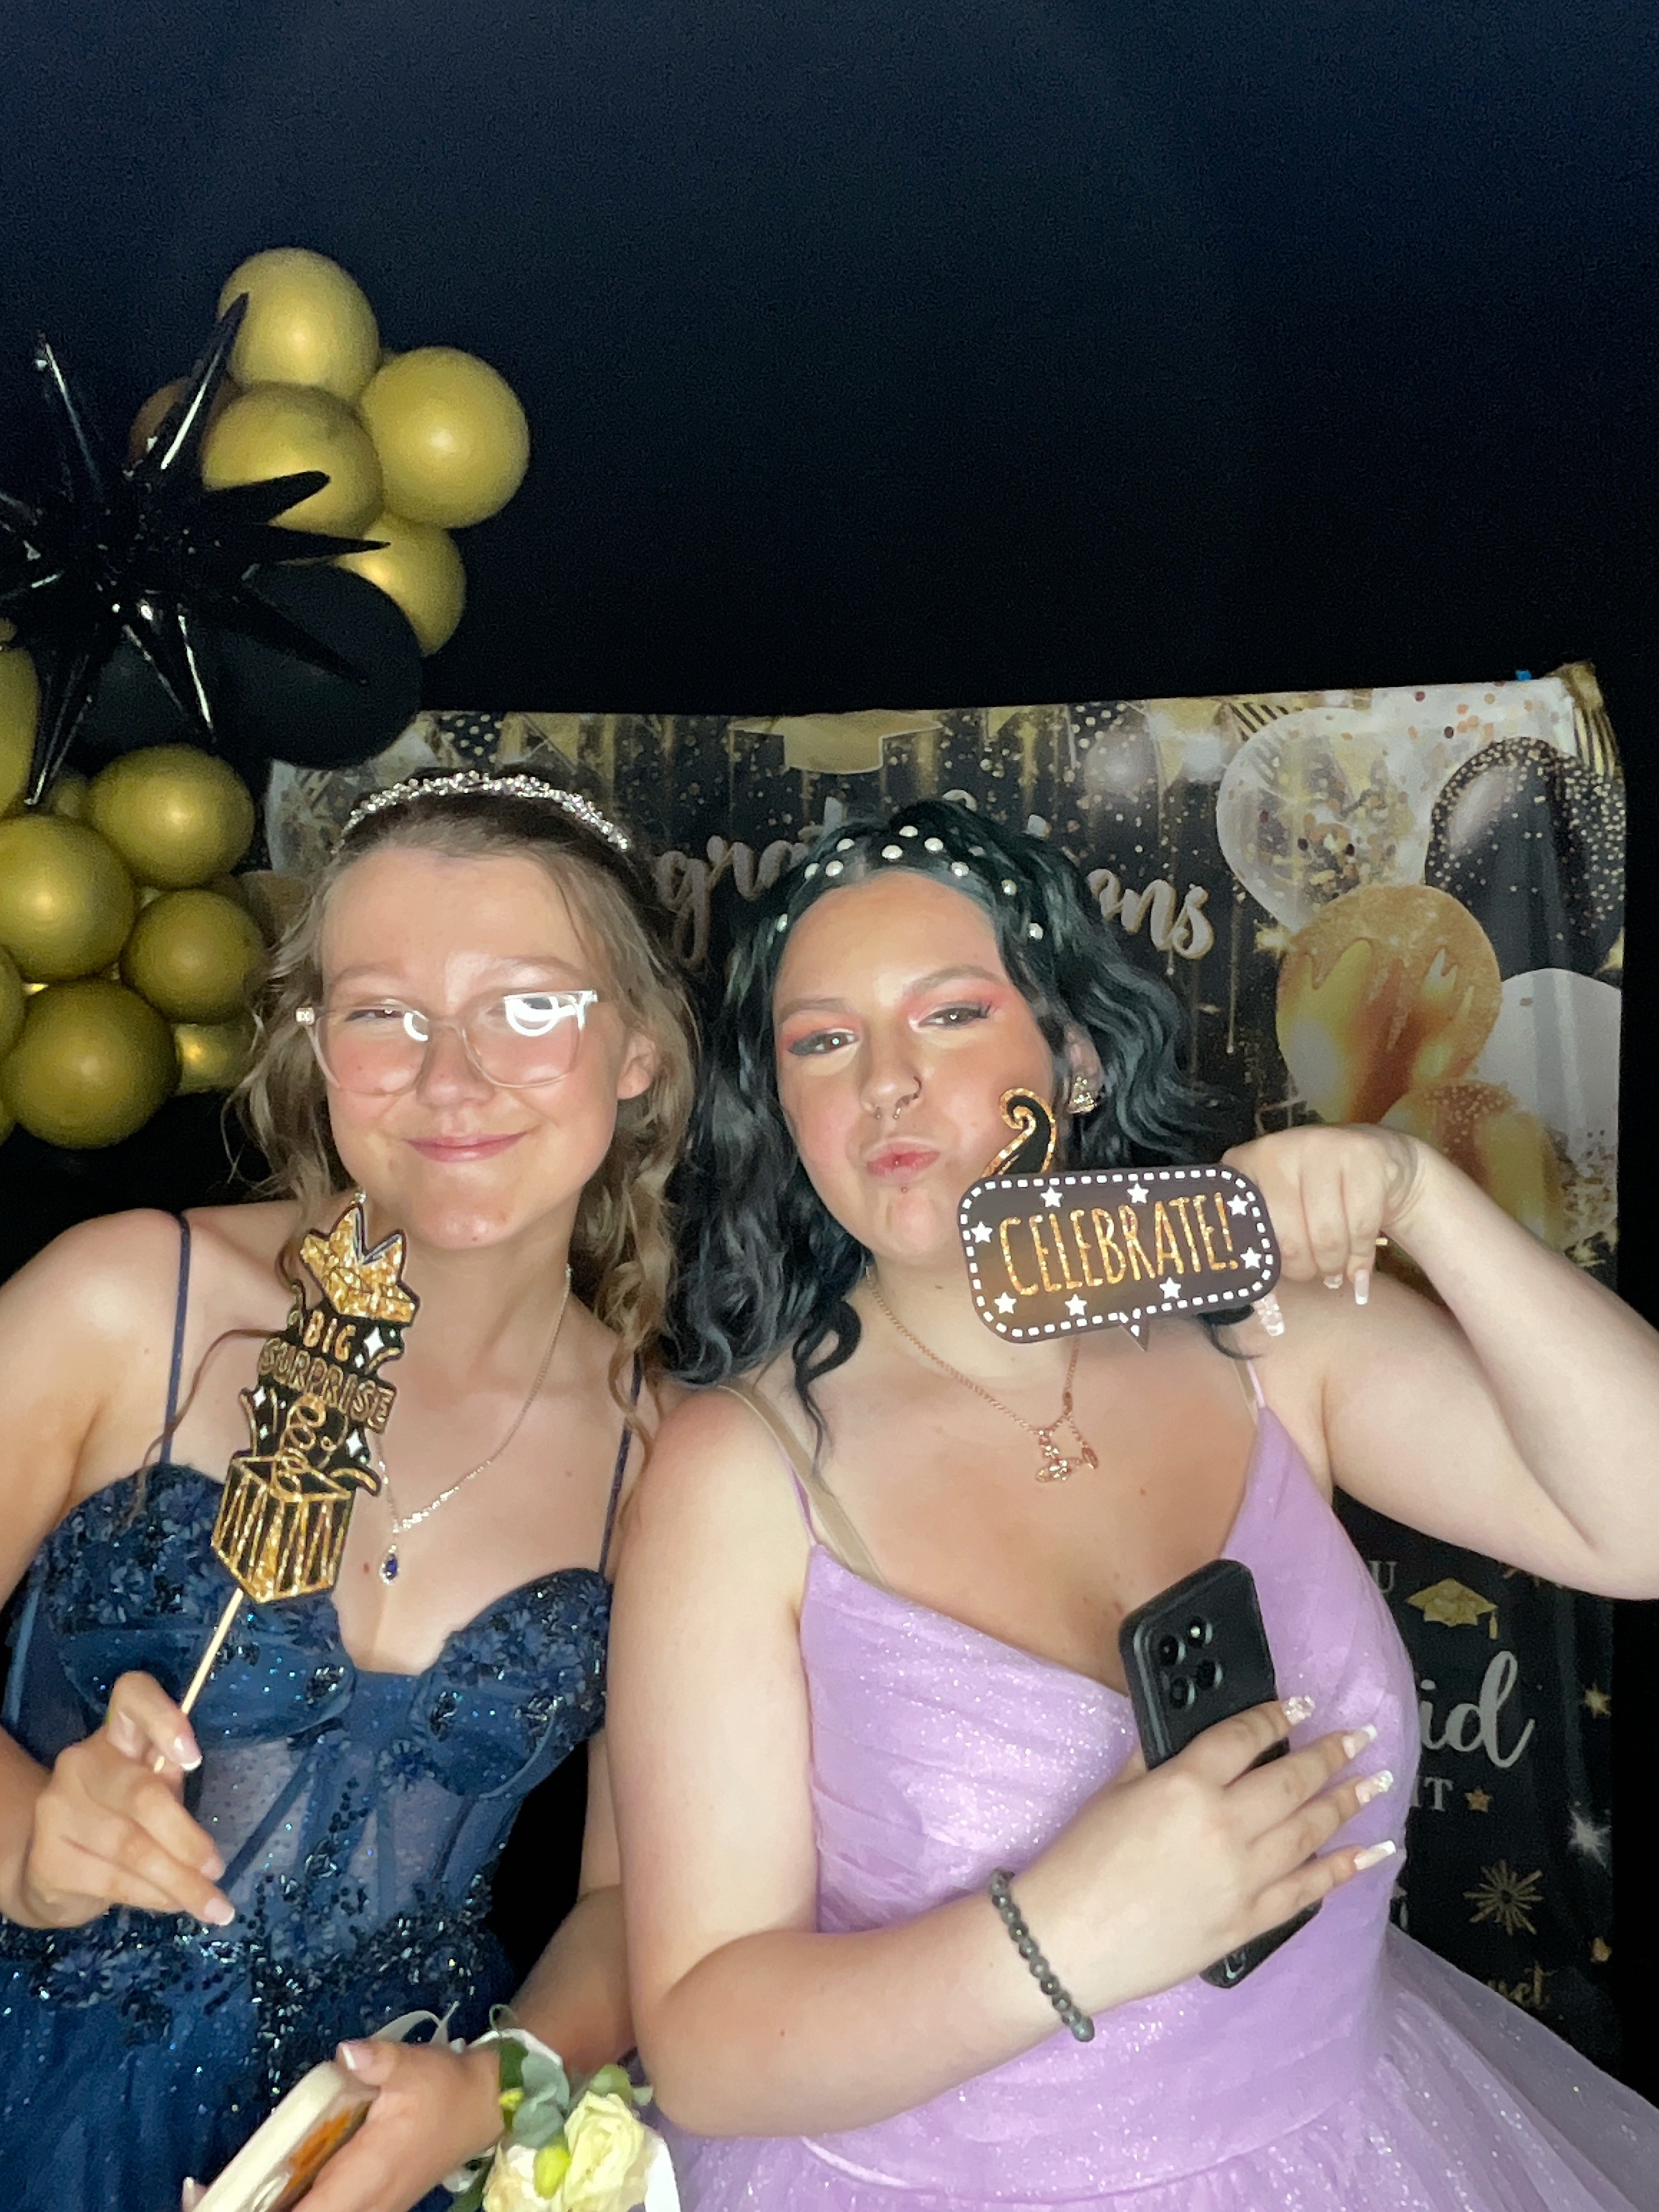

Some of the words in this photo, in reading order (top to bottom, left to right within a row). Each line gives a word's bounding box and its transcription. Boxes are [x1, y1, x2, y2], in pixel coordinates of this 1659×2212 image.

[999, 1191, 1239, 1296] CELEBRATE!
[257, 1336, 398, 1435] SURPRISE
[302, 1309, 357, 1362] BIG
[1419, 1650, 1536, 1769] id
